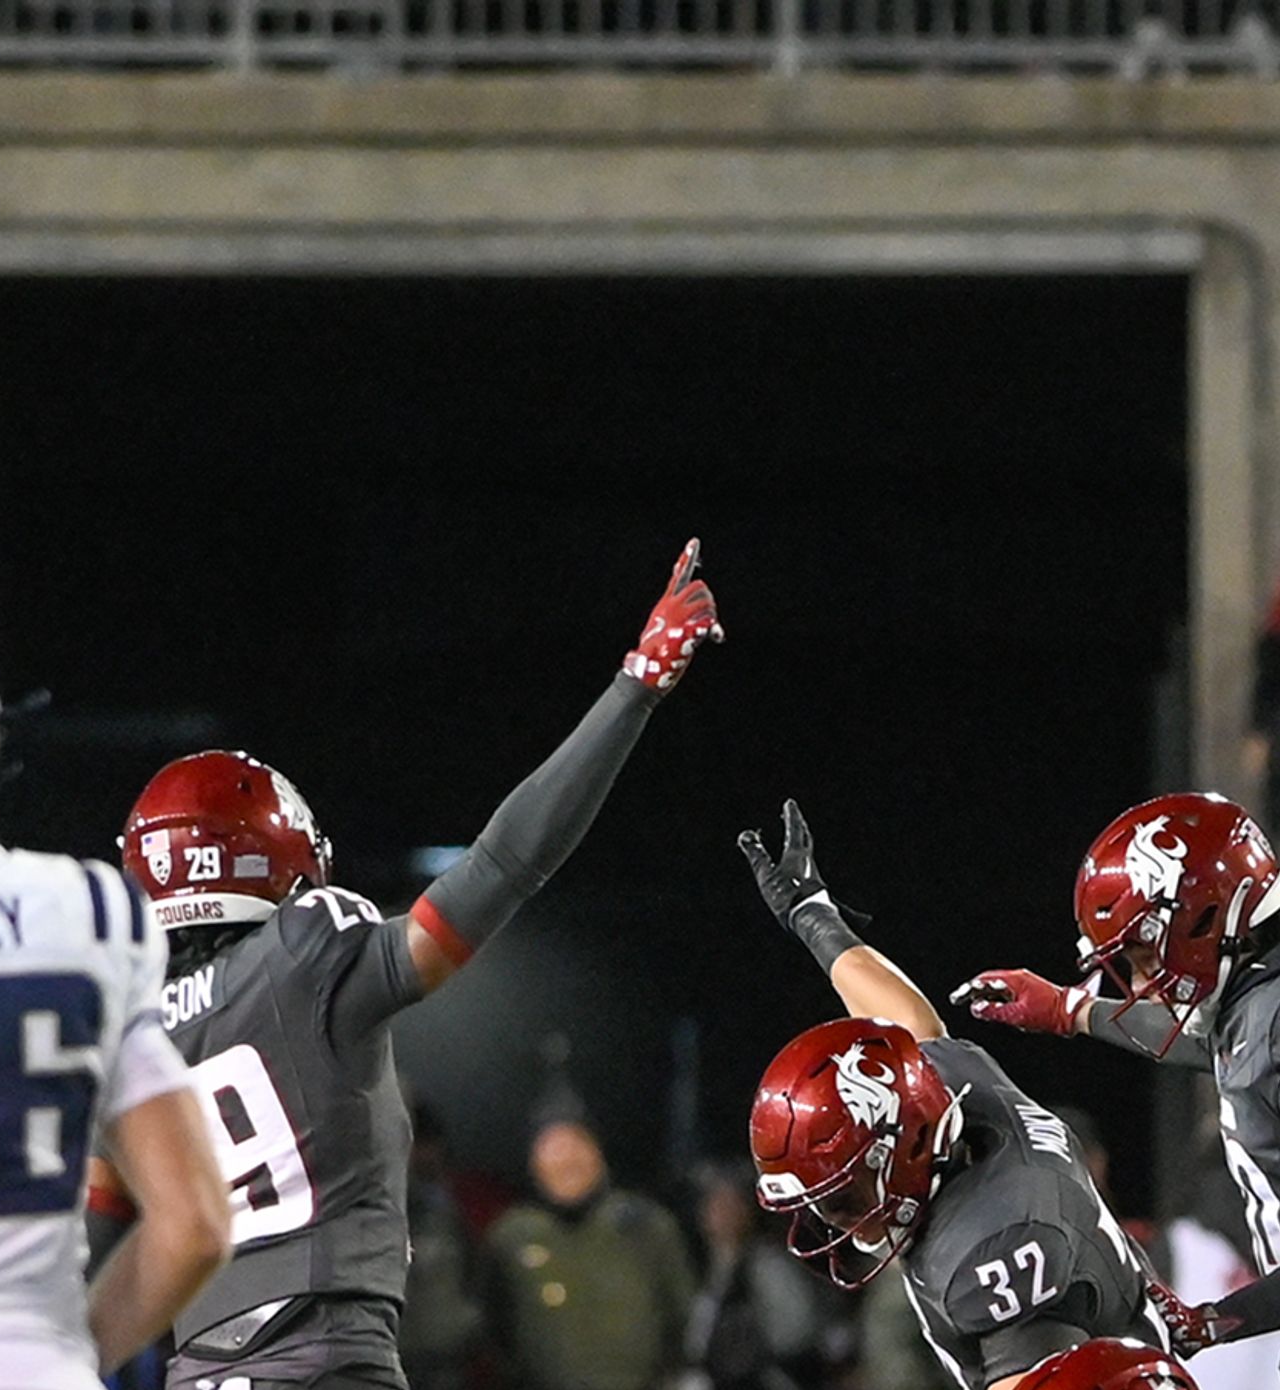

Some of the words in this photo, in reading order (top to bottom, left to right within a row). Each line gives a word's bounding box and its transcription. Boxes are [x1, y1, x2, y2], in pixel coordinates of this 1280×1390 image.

[184, 846, 222, 881] 29
[155, 901, 224, 925] COUGARS
[975, 1240, 1058, 1322] 32
